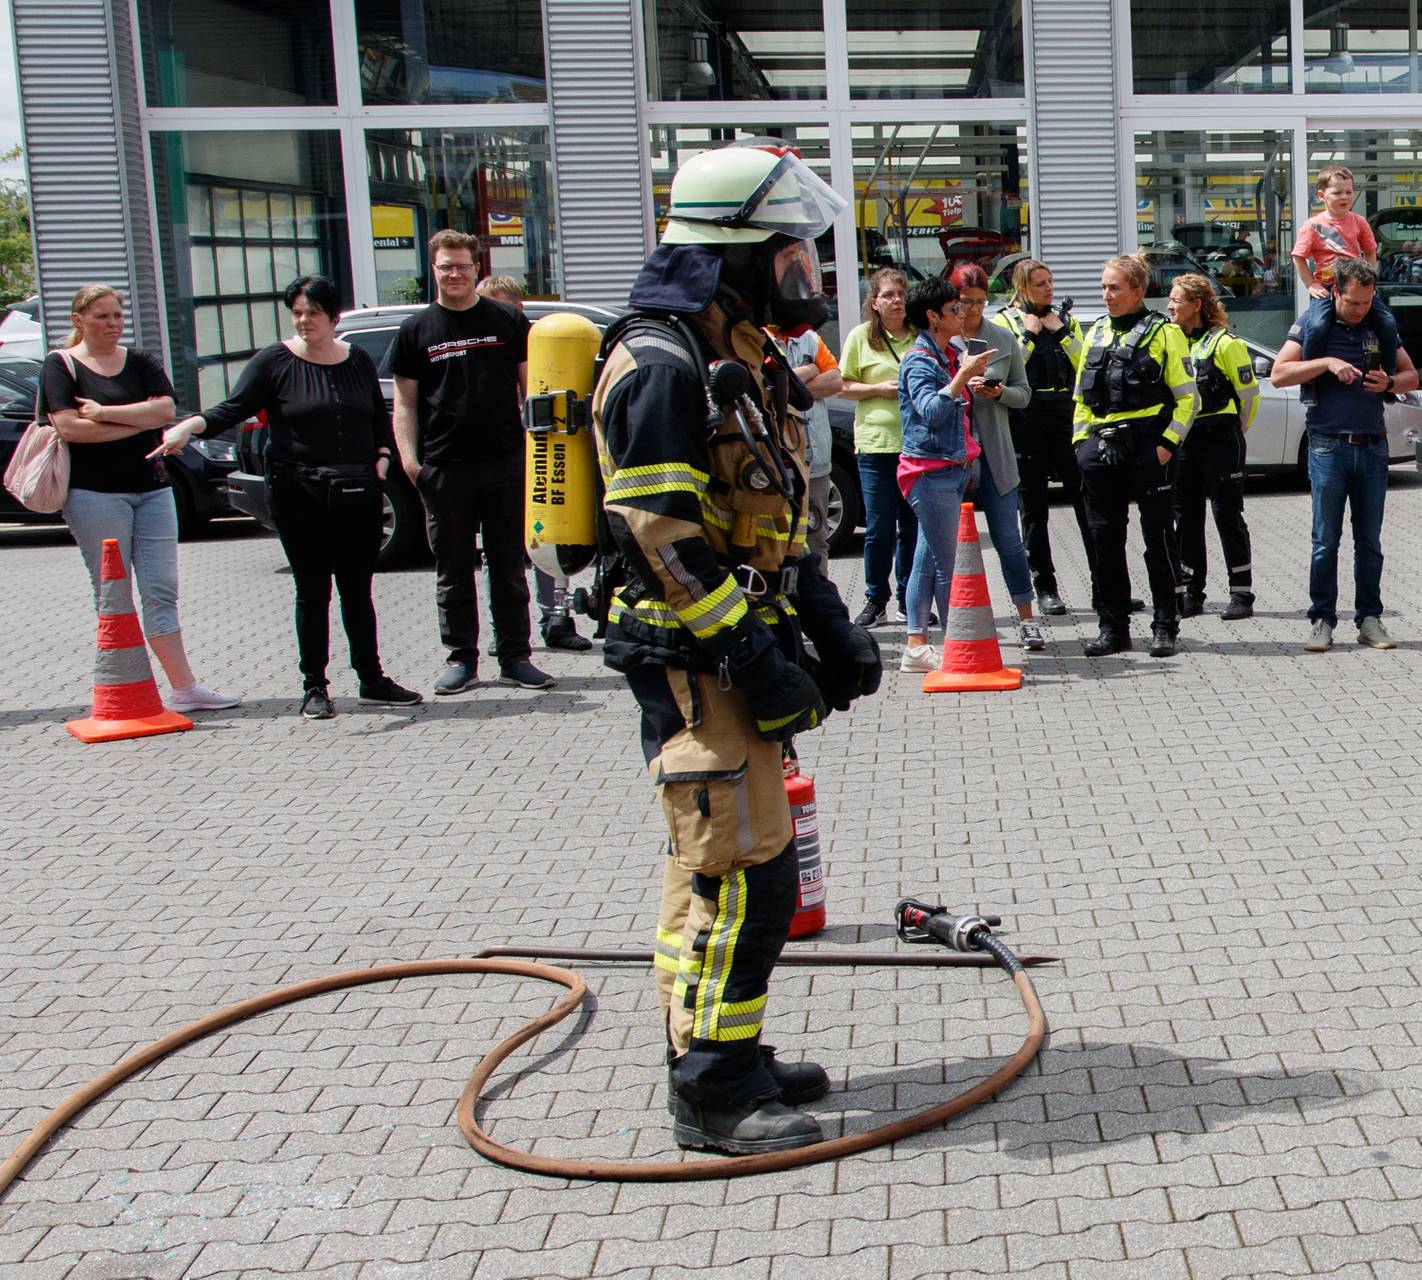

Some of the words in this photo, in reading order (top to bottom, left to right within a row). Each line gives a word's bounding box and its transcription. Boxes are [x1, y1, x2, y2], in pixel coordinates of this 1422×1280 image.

[427, 335, 497, 353] PORSCHE
[430, 349, 467, 363] MOTORSPORT
[532, 430, 549, 505] Atemluft
[551, 442, 566, 484] Essen
[551, 489, 566, 506] BF
